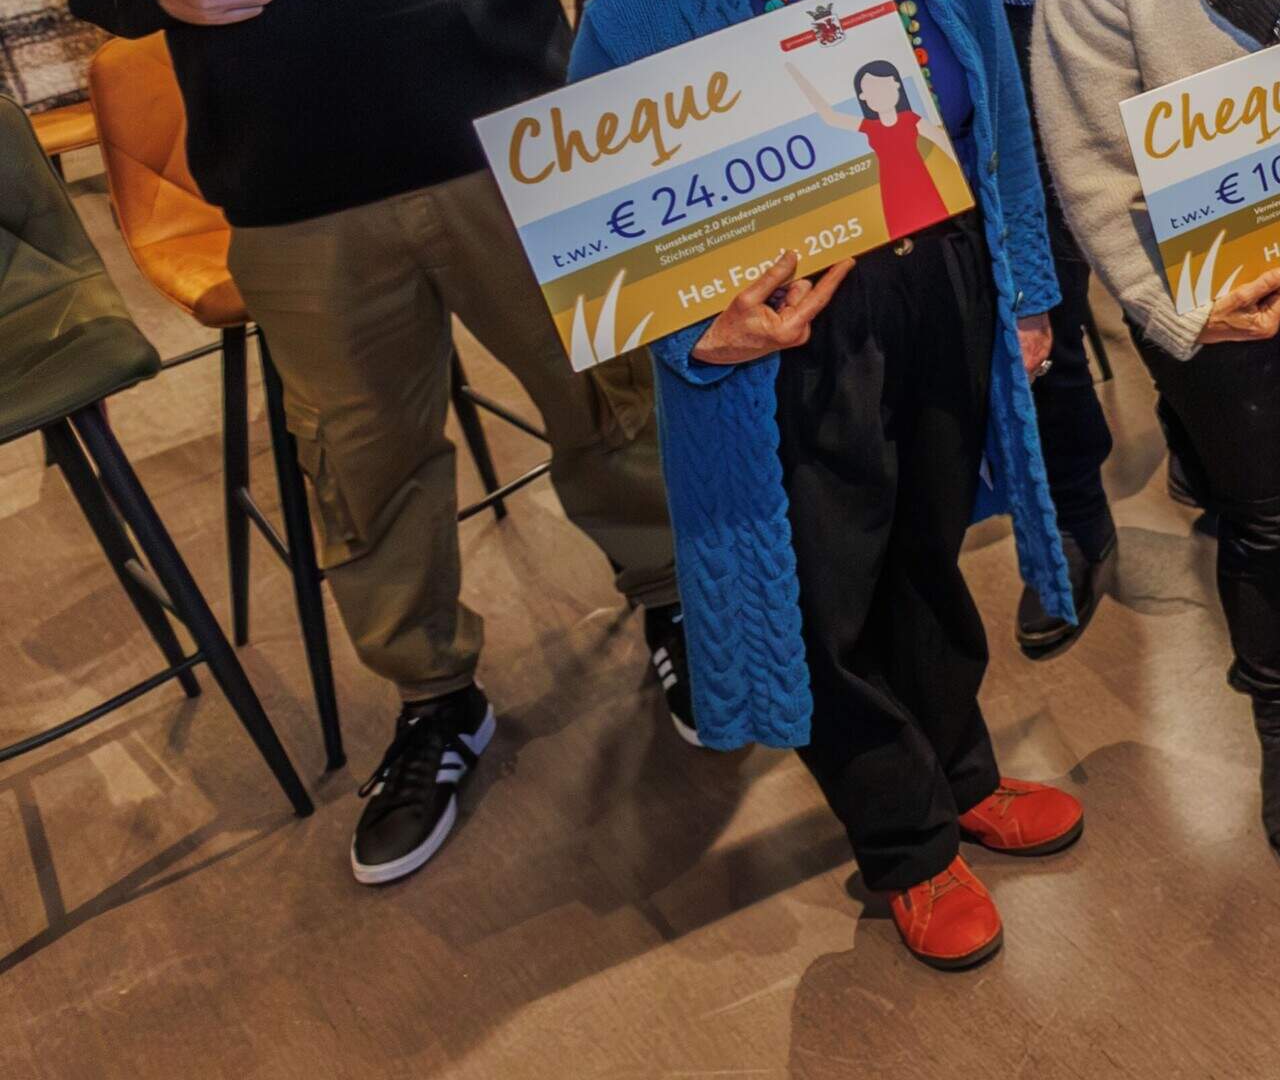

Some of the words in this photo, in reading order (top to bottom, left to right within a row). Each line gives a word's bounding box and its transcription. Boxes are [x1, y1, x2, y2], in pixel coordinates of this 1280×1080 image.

[508, 71, 742, 184] Cheque
[552, 239, 608, 267] t.w.v.
[606, 199, 646, 238] €
[651, 134, 815, 226] 24.000
[654, 228, 703, 253] Kunstkeet
[703, 220, 720, 233] 2.0
[720, 197, 781, 226] Kinderatelier
[782, 191, 796, 201] op
[795, 180, 821, 196] maat
[821, 159, 871, 186] 2026-2027
[659, 241, 705, 266] Stichting
[705, 218, 755, 246] Kunstwerf
[1171, 206, 1215, 229] t.w.v.
[1215, 172, 1245, 204] €
[677, 278, 726, 308] Het
[804, 217, 862, 255] 2025
